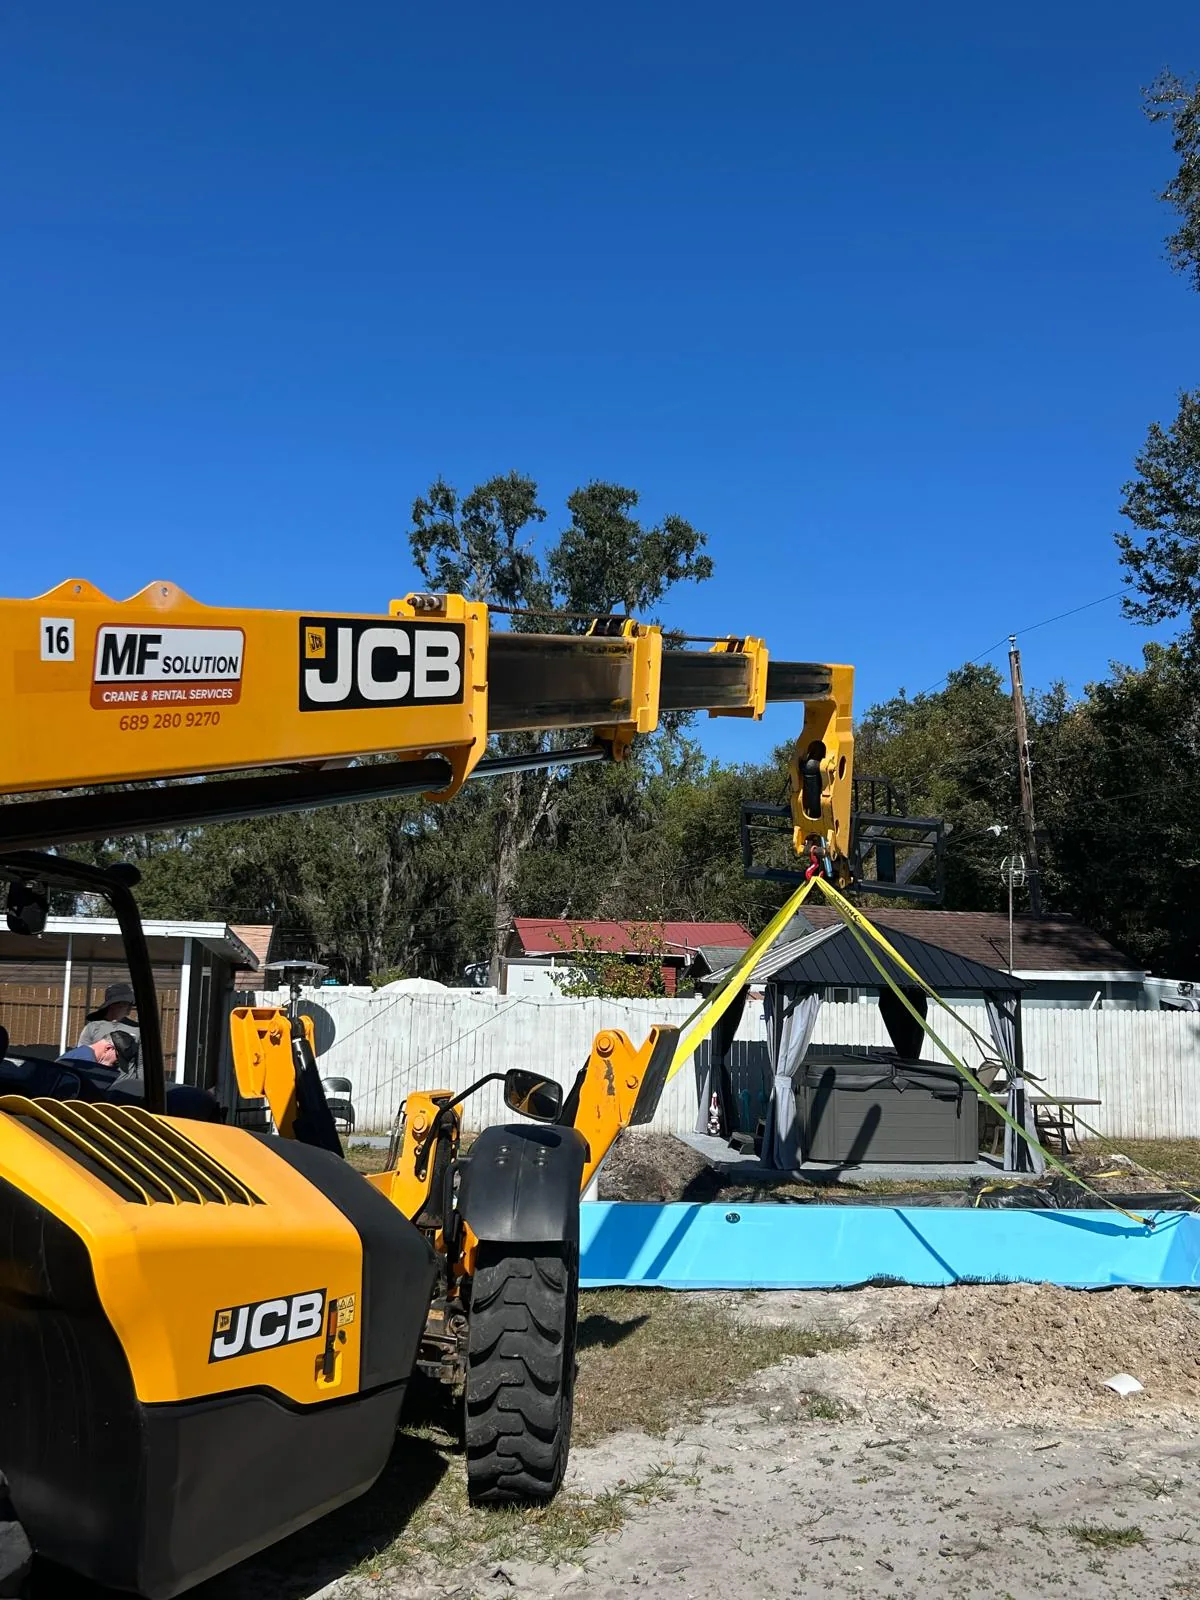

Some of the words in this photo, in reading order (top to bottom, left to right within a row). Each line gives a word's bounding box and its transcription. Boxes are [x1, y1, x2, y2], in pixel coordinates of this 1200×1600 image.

[46, 626, 69, 654] 16
[100, 633, 162, 675] MF
[162, 656, 239, 674] SOLUTION
[305, 627, 461, 703] JCB
[103, 691, 139, 702] CRANE
[141, 690, 149, 701] &
[152, 689, 187, 700] RENTAL
[189, 688, 233, 699] SERVICES
[119, 714, 150, 731] 689
[153, 712, 182, 729] 280
[185, 711, 220, 728] 9270
[213, 1292, 323, 1358] JCB
